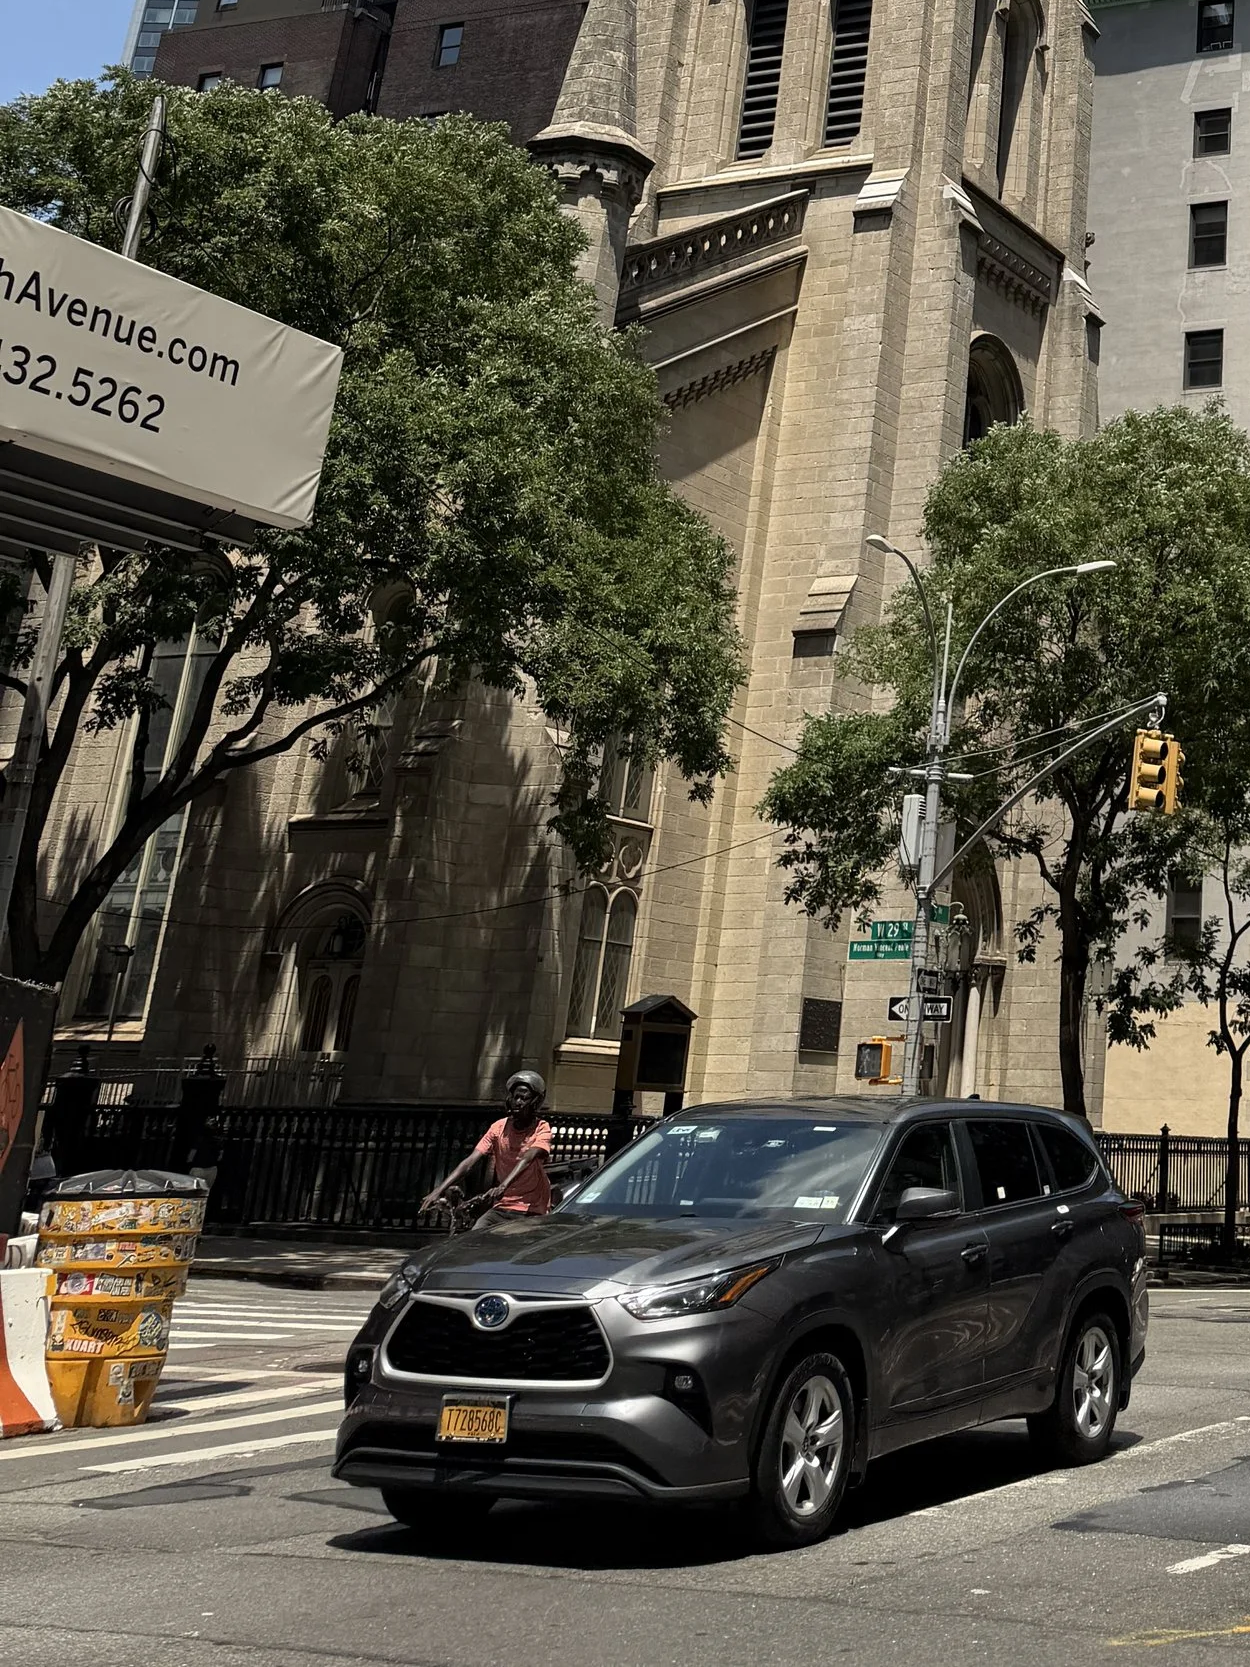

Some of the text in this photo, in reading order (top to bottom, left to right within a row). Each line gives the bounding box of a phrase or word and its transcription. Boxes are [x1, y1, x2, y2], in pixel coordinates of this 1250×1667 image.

[0, 339, 165, 433] 32.5262
[877, 923, 885, 938] W
[887, 922, 900, 938] 29
[898, 1004, 945, 1014] ON WAY
[446, 1408, 502, 1433] T728568C
